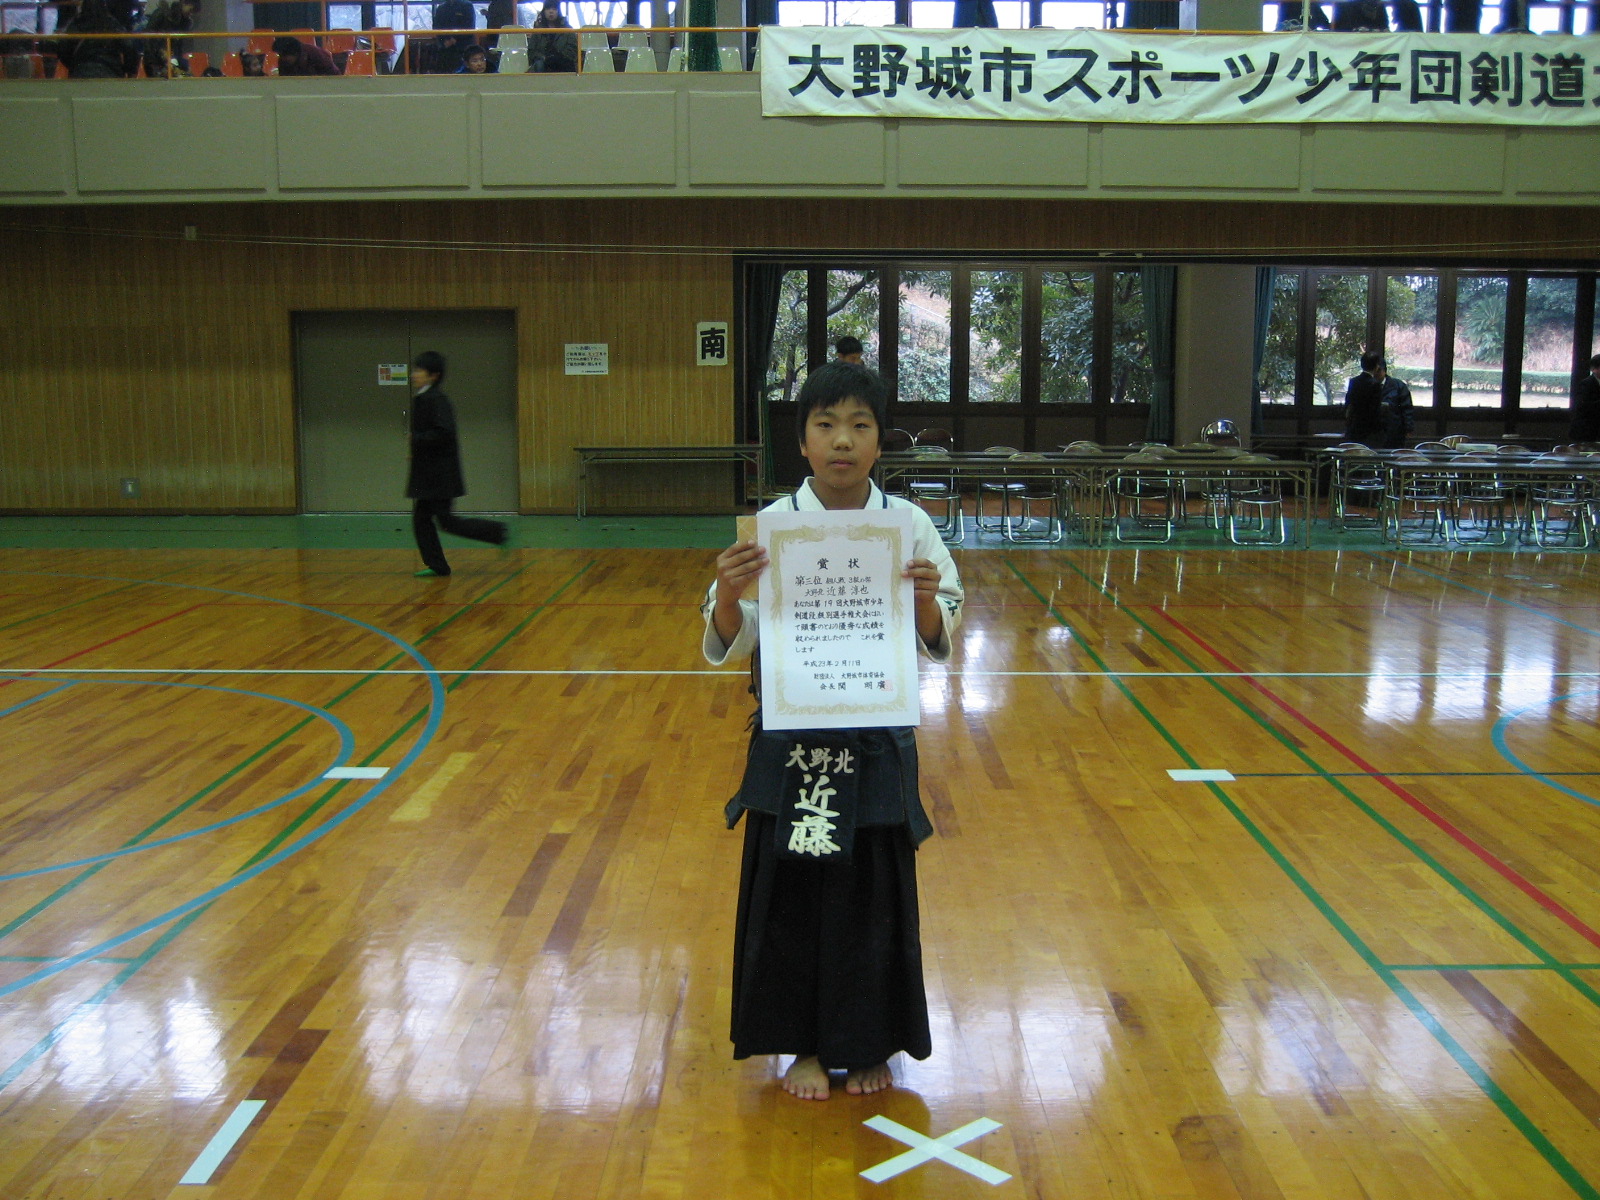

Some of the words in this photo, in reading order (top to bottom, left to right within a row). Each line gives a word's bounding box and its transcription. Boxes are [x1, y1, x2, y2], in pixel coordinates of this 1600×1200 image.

[788, 44, 1600, 107] 大野城市スポーツ少年団剣道
[699, 327, 726, 360] 南
[795, 575, 822, 586] 第三位
[785, 743, 854, 774] 大野北
[787, 774, 842, 857] 近藤
